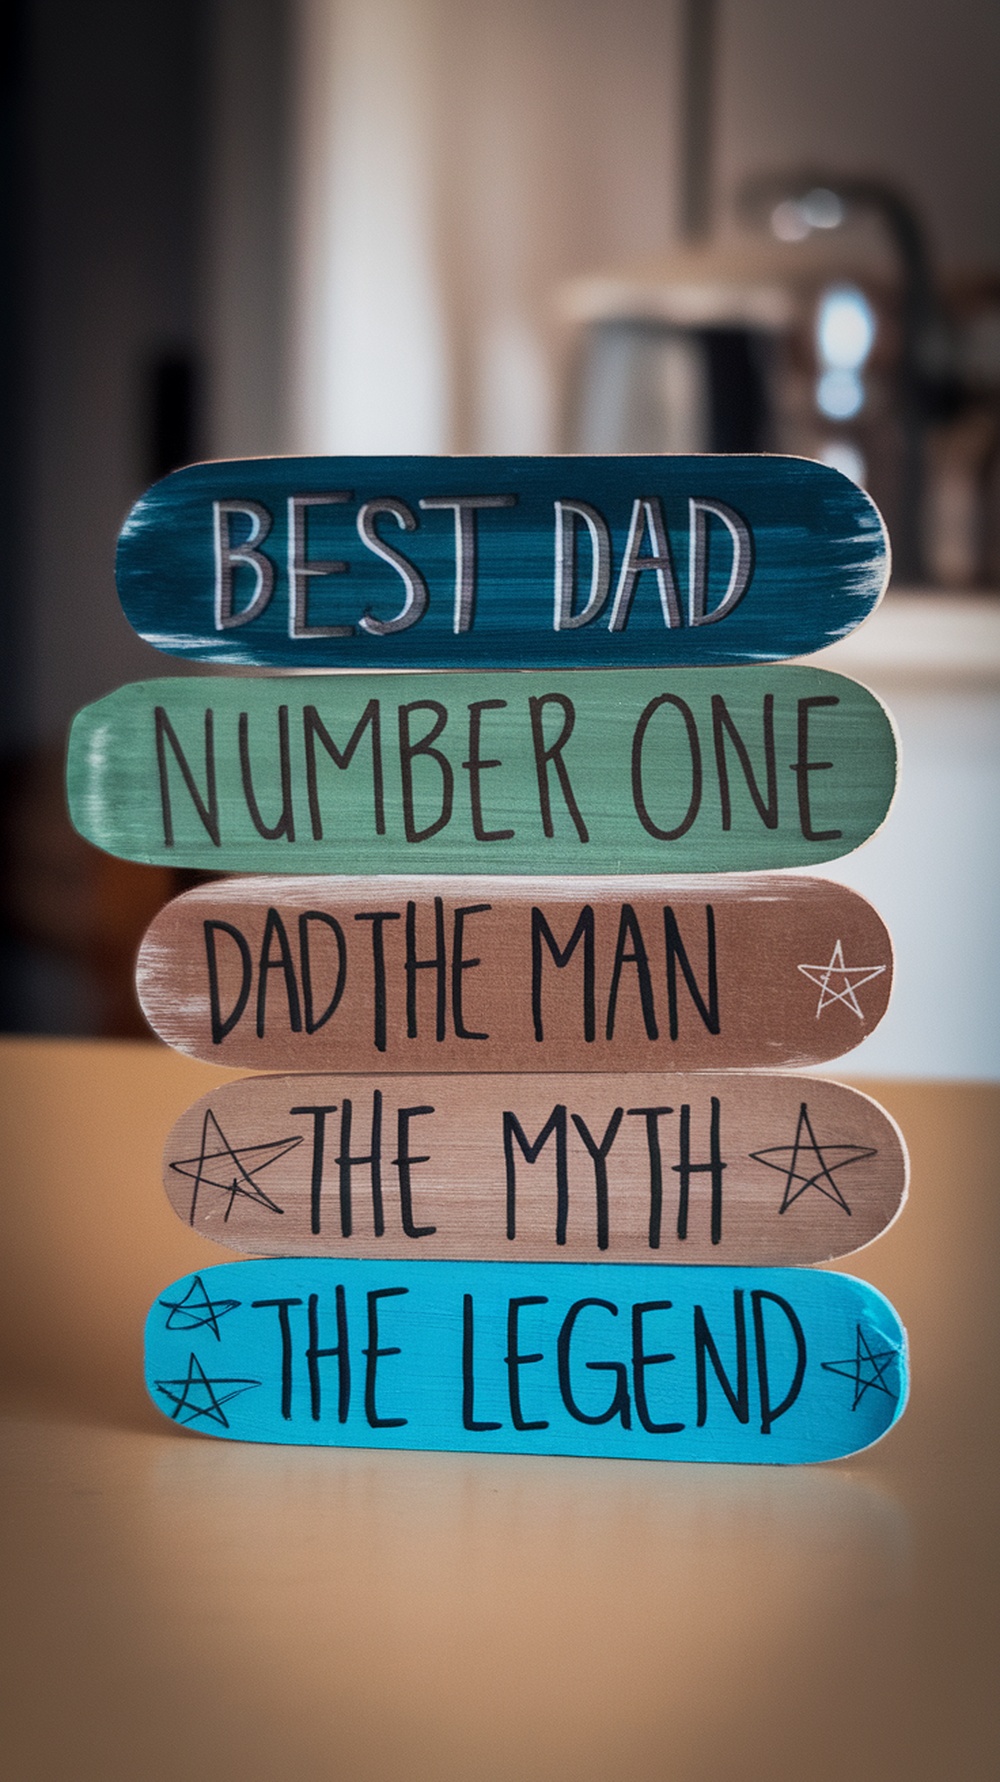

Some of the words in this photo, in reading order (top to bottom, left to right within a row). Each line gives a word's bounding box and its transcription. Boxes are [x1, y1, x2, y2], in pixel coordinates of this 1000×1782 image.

[212, 491, 518, 639] BEST
[554, 497, 755, 632] DAD
[154, 693, 590, 848] NUMBER
[632, 693, 843, 842] ONE
[530, 903, 720, 1042] MAN
[290, 1090, 436, 1237] THE
[503, 1096, 727, 1250] MYTH
[252, 1285, 408, 1428] THE
[462, 1288, 807, 1434] LEGEND
